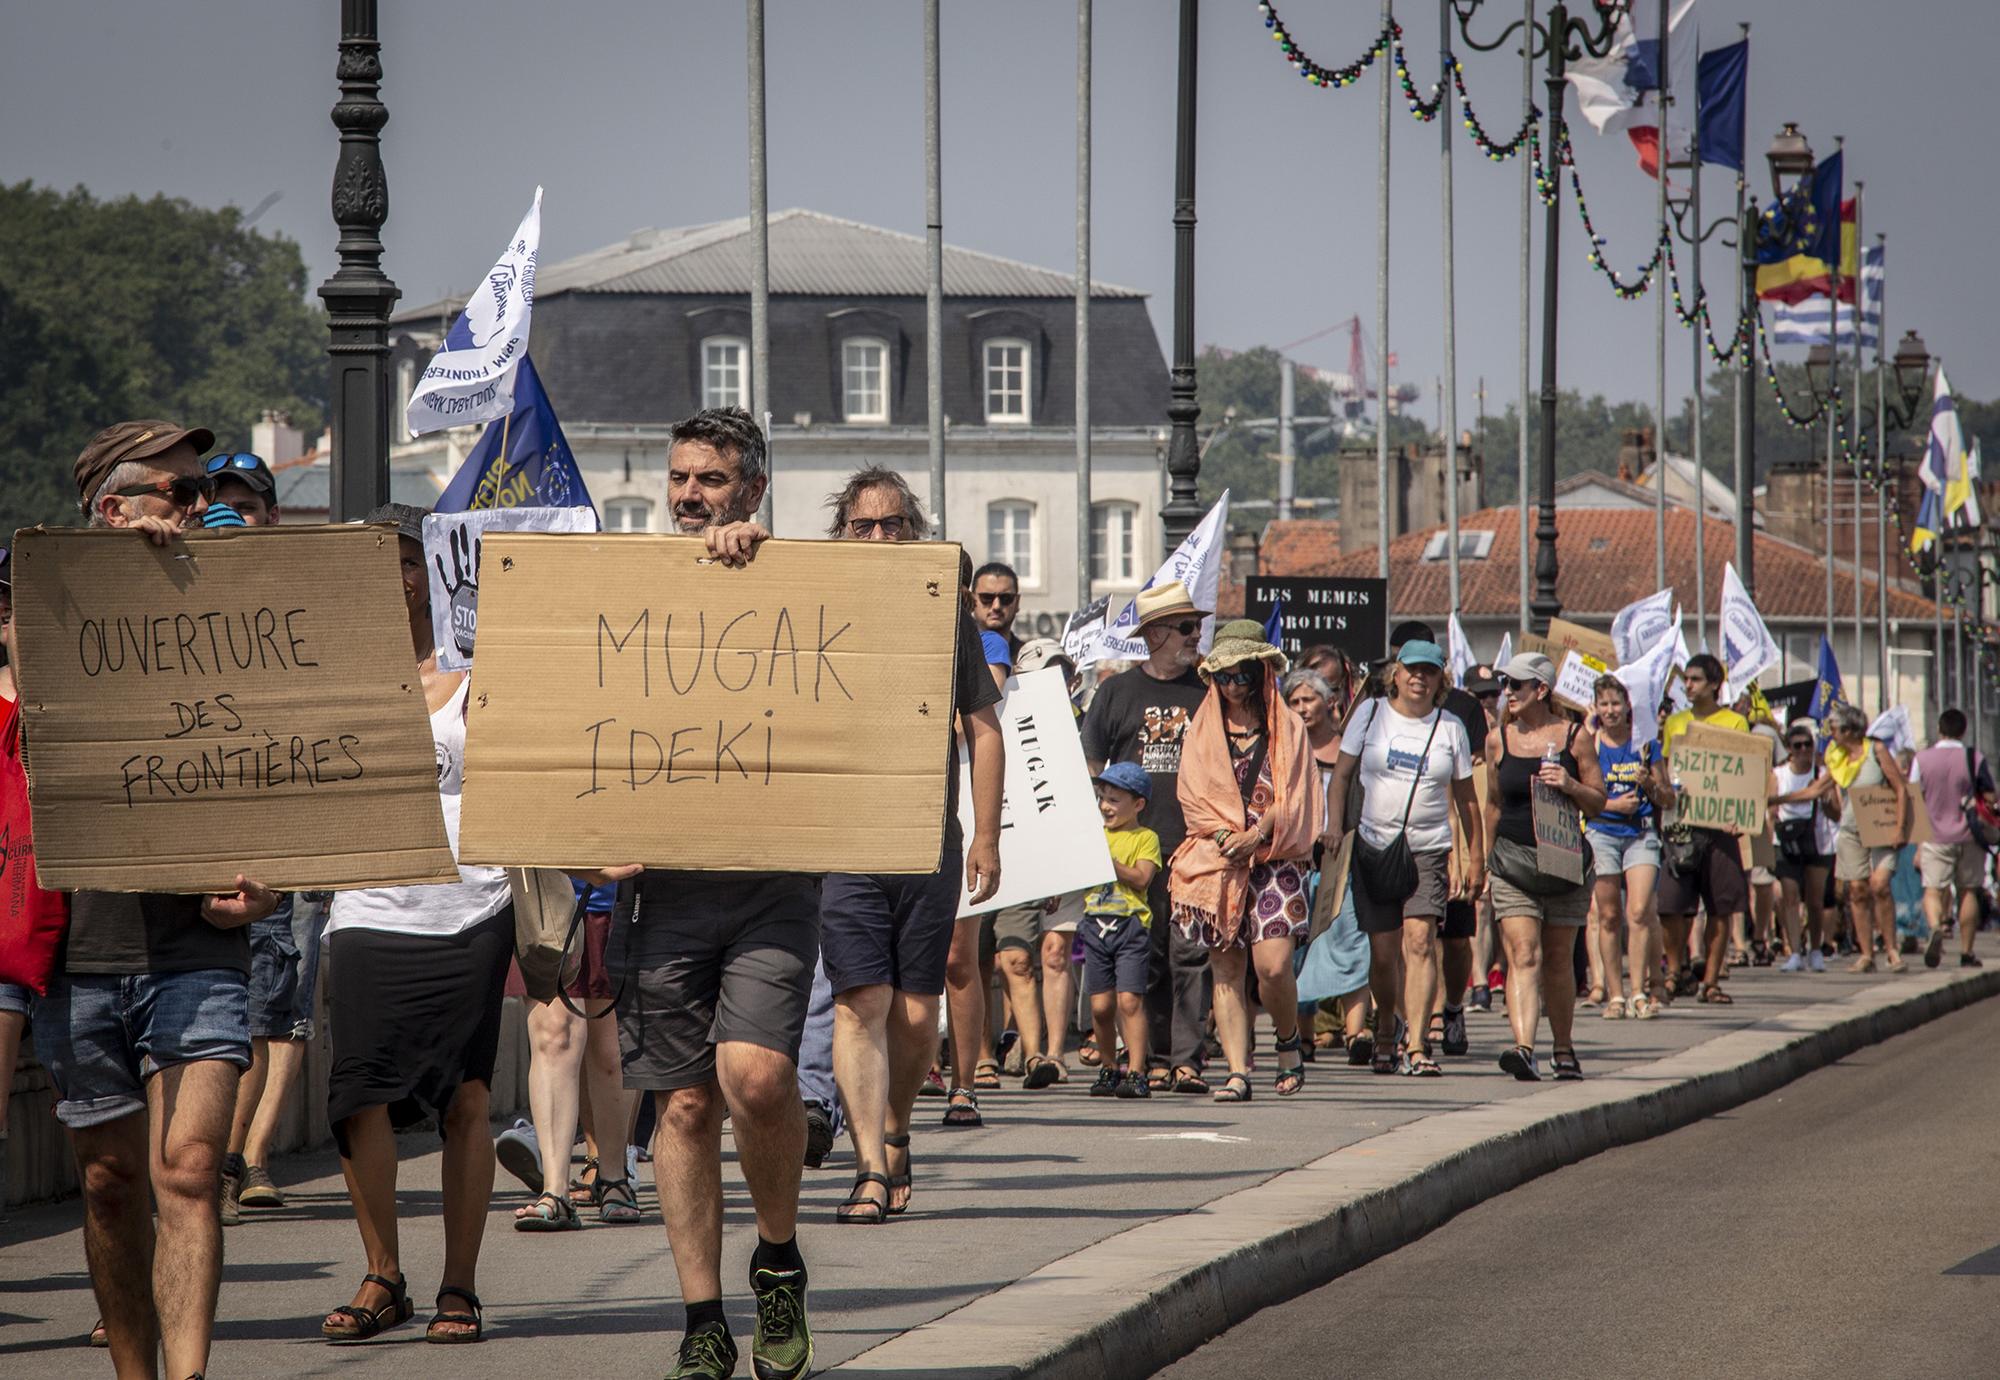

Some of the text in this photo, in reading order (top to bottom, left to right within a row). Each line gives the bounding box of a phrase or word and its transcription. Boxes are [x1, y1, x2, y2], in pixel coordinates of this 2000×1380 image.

[454, 604, 477, 631] STO
[1256, 587, 1370, 606] LES MEMES
[79, 608, 319, 677] OUVERTURE
[598, 604, 854, 702] MUGAK
[165, 694, 243, 739] DES
[121, 729, 363, 808] FRONTIÈRES
[1015, 714, 1057, 814] MUGAK
[632, 893, 641, 923] Canon
